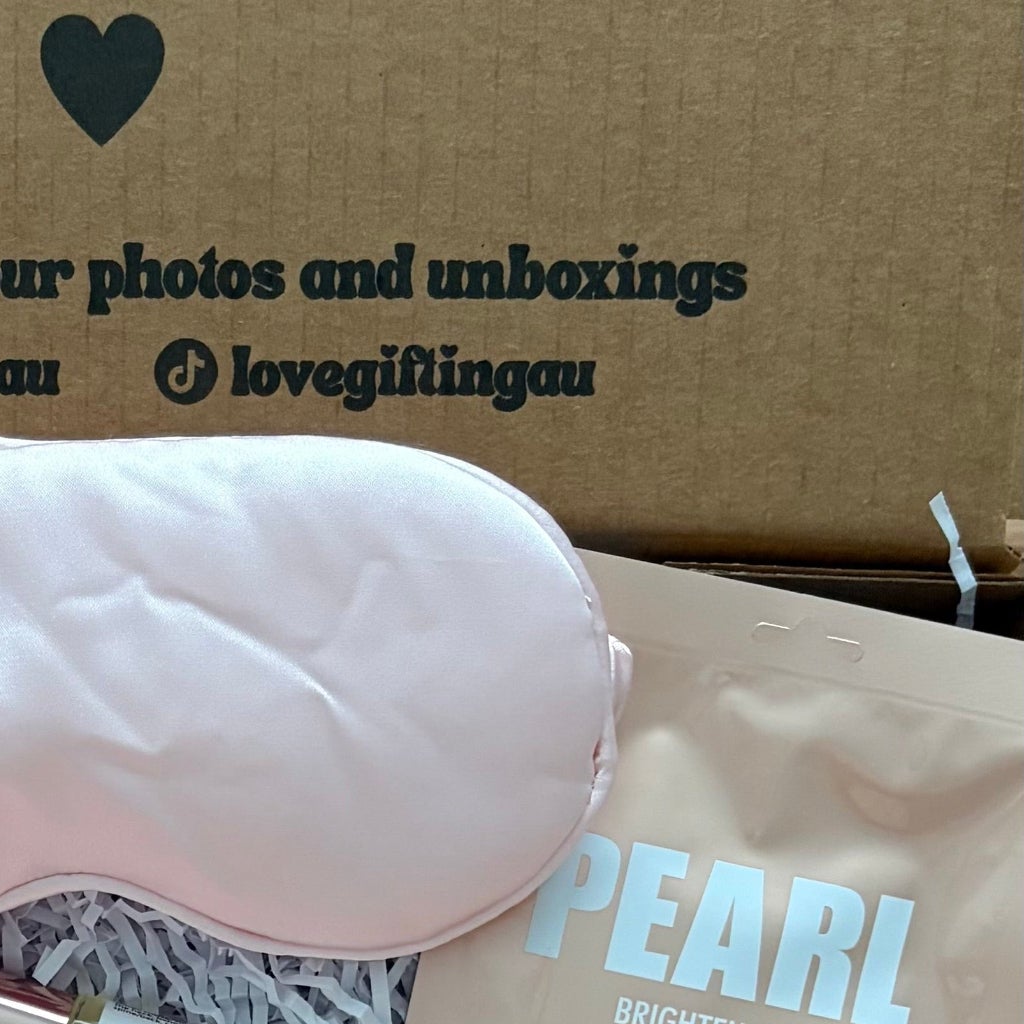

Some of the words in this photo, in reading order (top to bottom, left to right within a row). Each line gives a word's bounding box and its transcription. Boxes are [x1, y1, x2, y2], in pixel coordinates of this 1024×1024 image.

[87, 242, 285, 316] photos
[300, 243, 415, 300] and
[427, 243, 747, 317] unboxings
[230, 344, 596, 412] lovegiftingau
